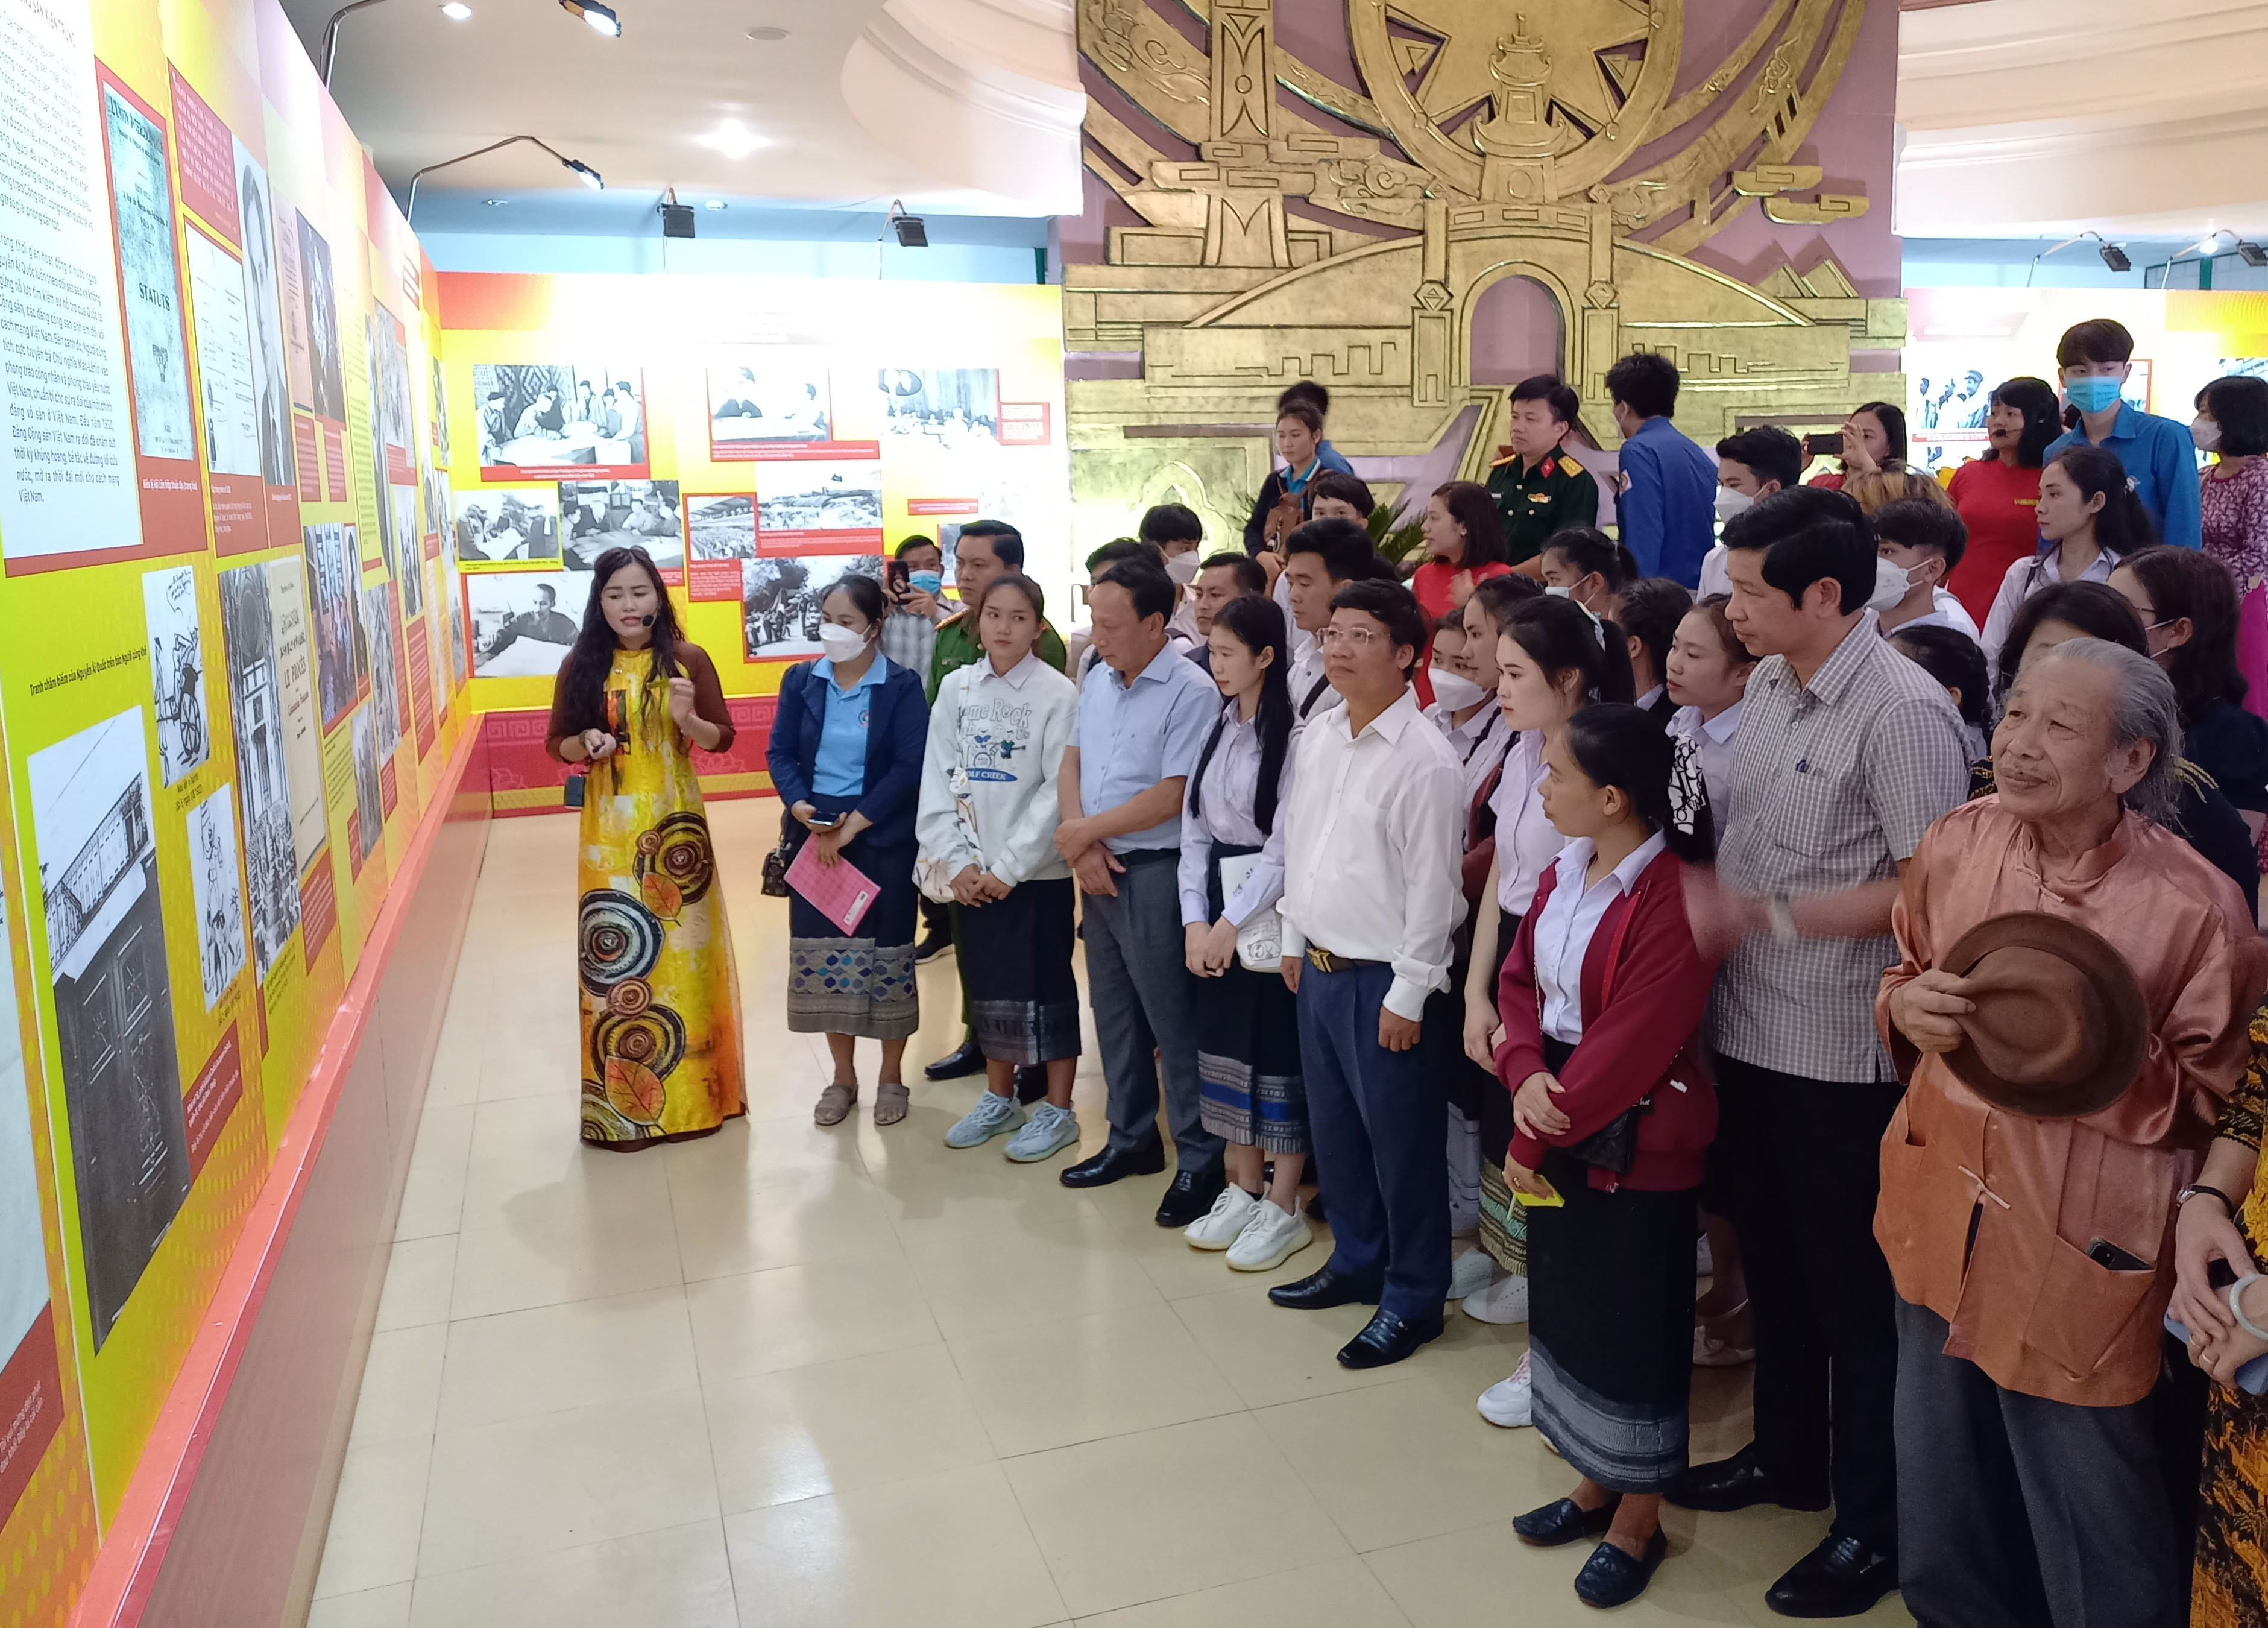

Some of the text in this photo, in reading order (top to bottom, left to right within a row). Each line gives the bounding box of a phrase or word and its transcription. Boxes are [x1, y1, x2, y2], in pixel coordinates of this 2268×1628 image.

[1, 234, 14, 252] rong
[138, 281, 170, 312] STATUTS
[18, 488, 44, 505] Việt Nam.
[29, 680, 43, 696] Tranh
[42, 675, 57, 690] châm
[67, 667, 76, 682] của
[75, 661, 92, 682] Nguyễn
[96, 657, 107, 672] Quốc
[106, 655, 115, 669] trên
[122, 649, 132, 666] Người
[981, 772, 1007, 780] CREEK
